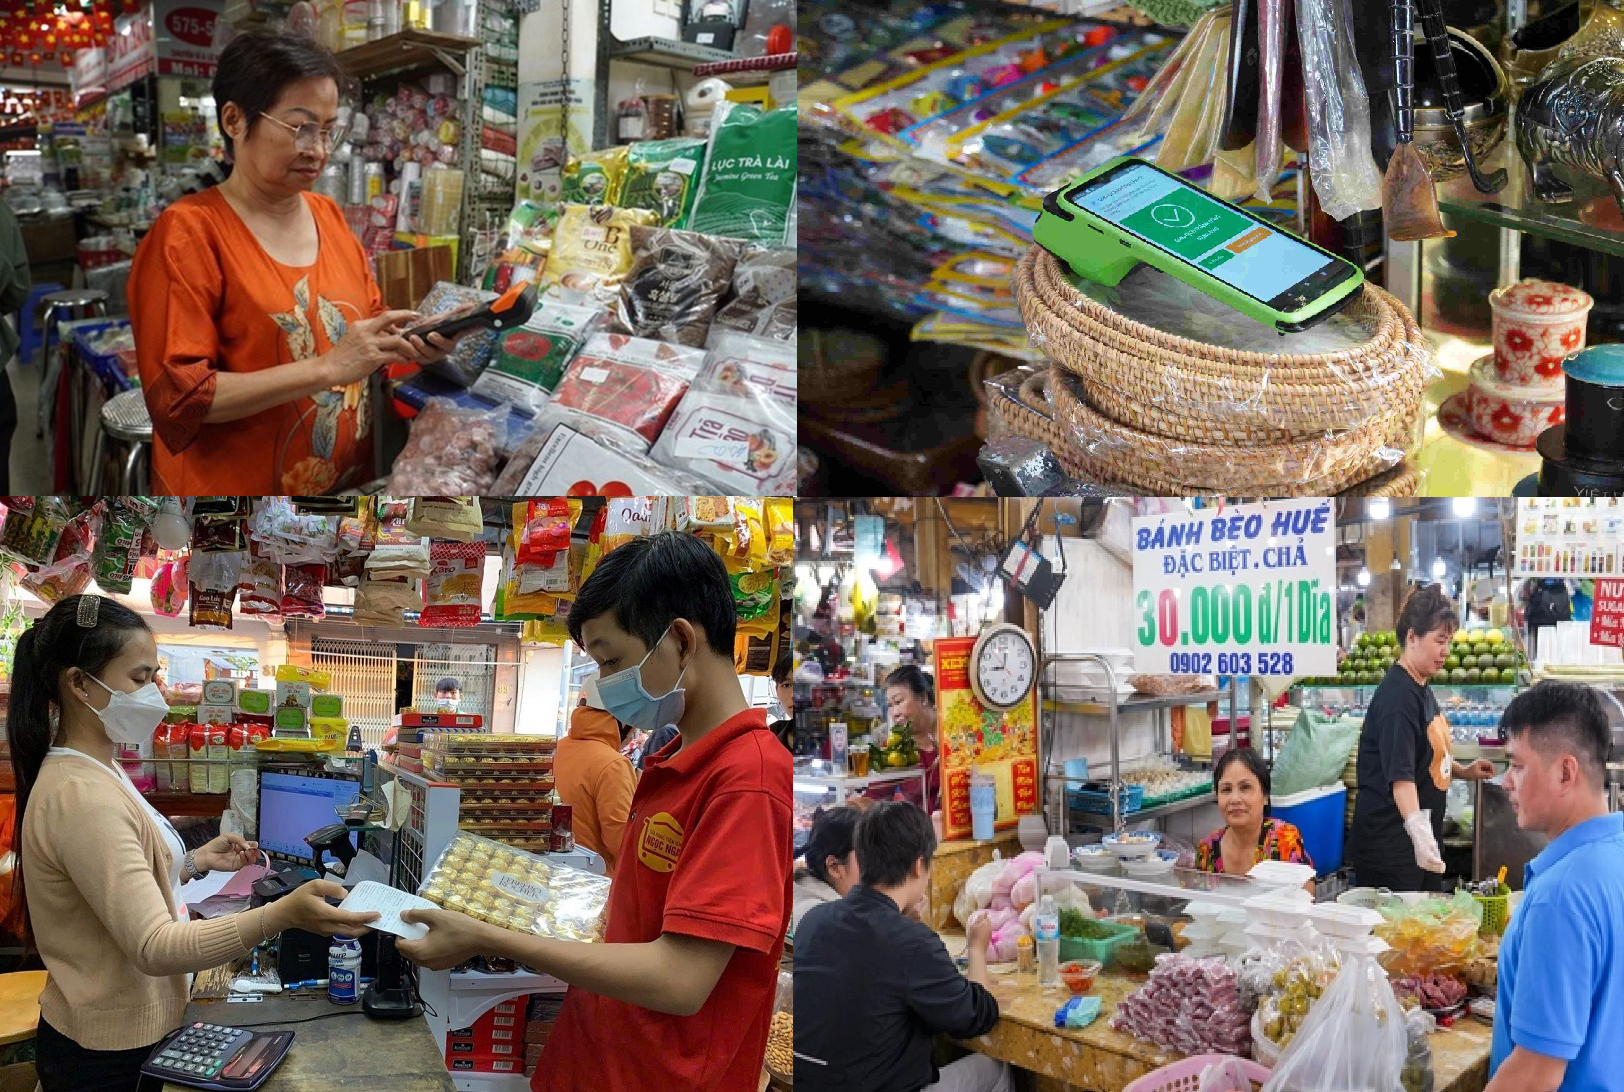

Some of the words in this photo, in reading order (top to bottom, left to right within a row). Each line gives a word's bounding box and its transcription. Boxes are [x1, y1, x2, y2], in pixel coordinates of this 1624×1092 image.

[711, 158, 735, 172] LỤC
[738, 154, 762, 168] TRÀ
[766, 155, 790, 169] LÀI
[740, 171, 762, 181] Green
[764, 171, 779, 181] Tea
[1136, 518, 1204, 550] BÁNH
[1210, 508, 1263, 542] BÈO
[1271, 498, 1331, 536] HUẾ
[430, 565, 456, 577] Karo
[1163, 549, 1204, 578] ĐẶC
[1137, 582, 1253, 648] 30.000
[1170, 652, 1213, 674] 0902
[1217, 652, 1252, 674] 603
[1257, 652, 1295, 675] 528
[645, 835, 664, 851] NGỌC
[498, 880, 540, 900] ROCHER
[501, 875, 543, 895] FERRERO
